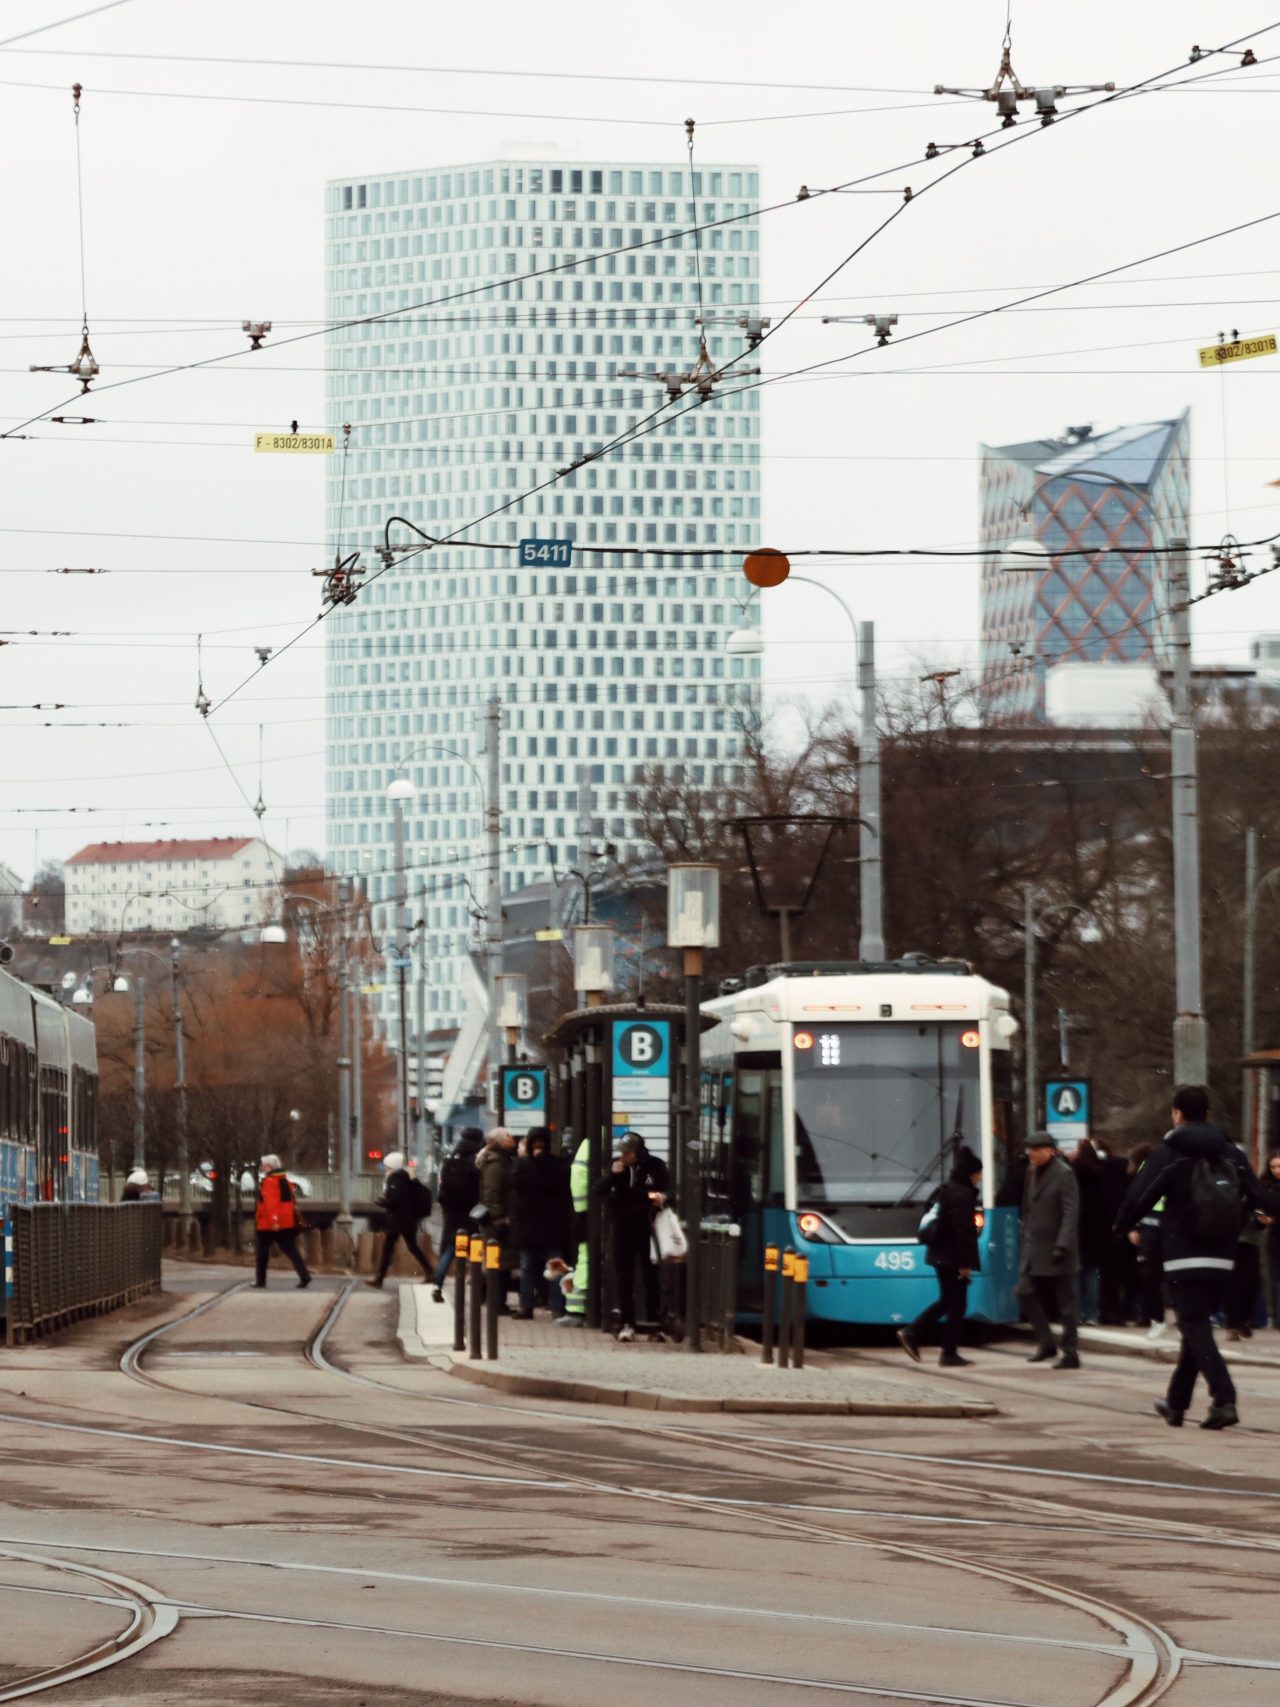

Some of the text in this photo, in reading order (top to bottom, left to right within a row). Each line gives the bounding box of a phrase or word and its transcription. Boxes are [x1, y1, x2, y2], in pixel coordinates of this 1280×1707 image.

[273, 437, 333, 449] 8302/8301A
[523, 544, 567, 562] 5411
[631, 1031, 653, 1062] B
[517, 1078, 533, 1100] B
[1058, 1089, 1077, 1112] A
[873, 1250, 915, 1271] 495
